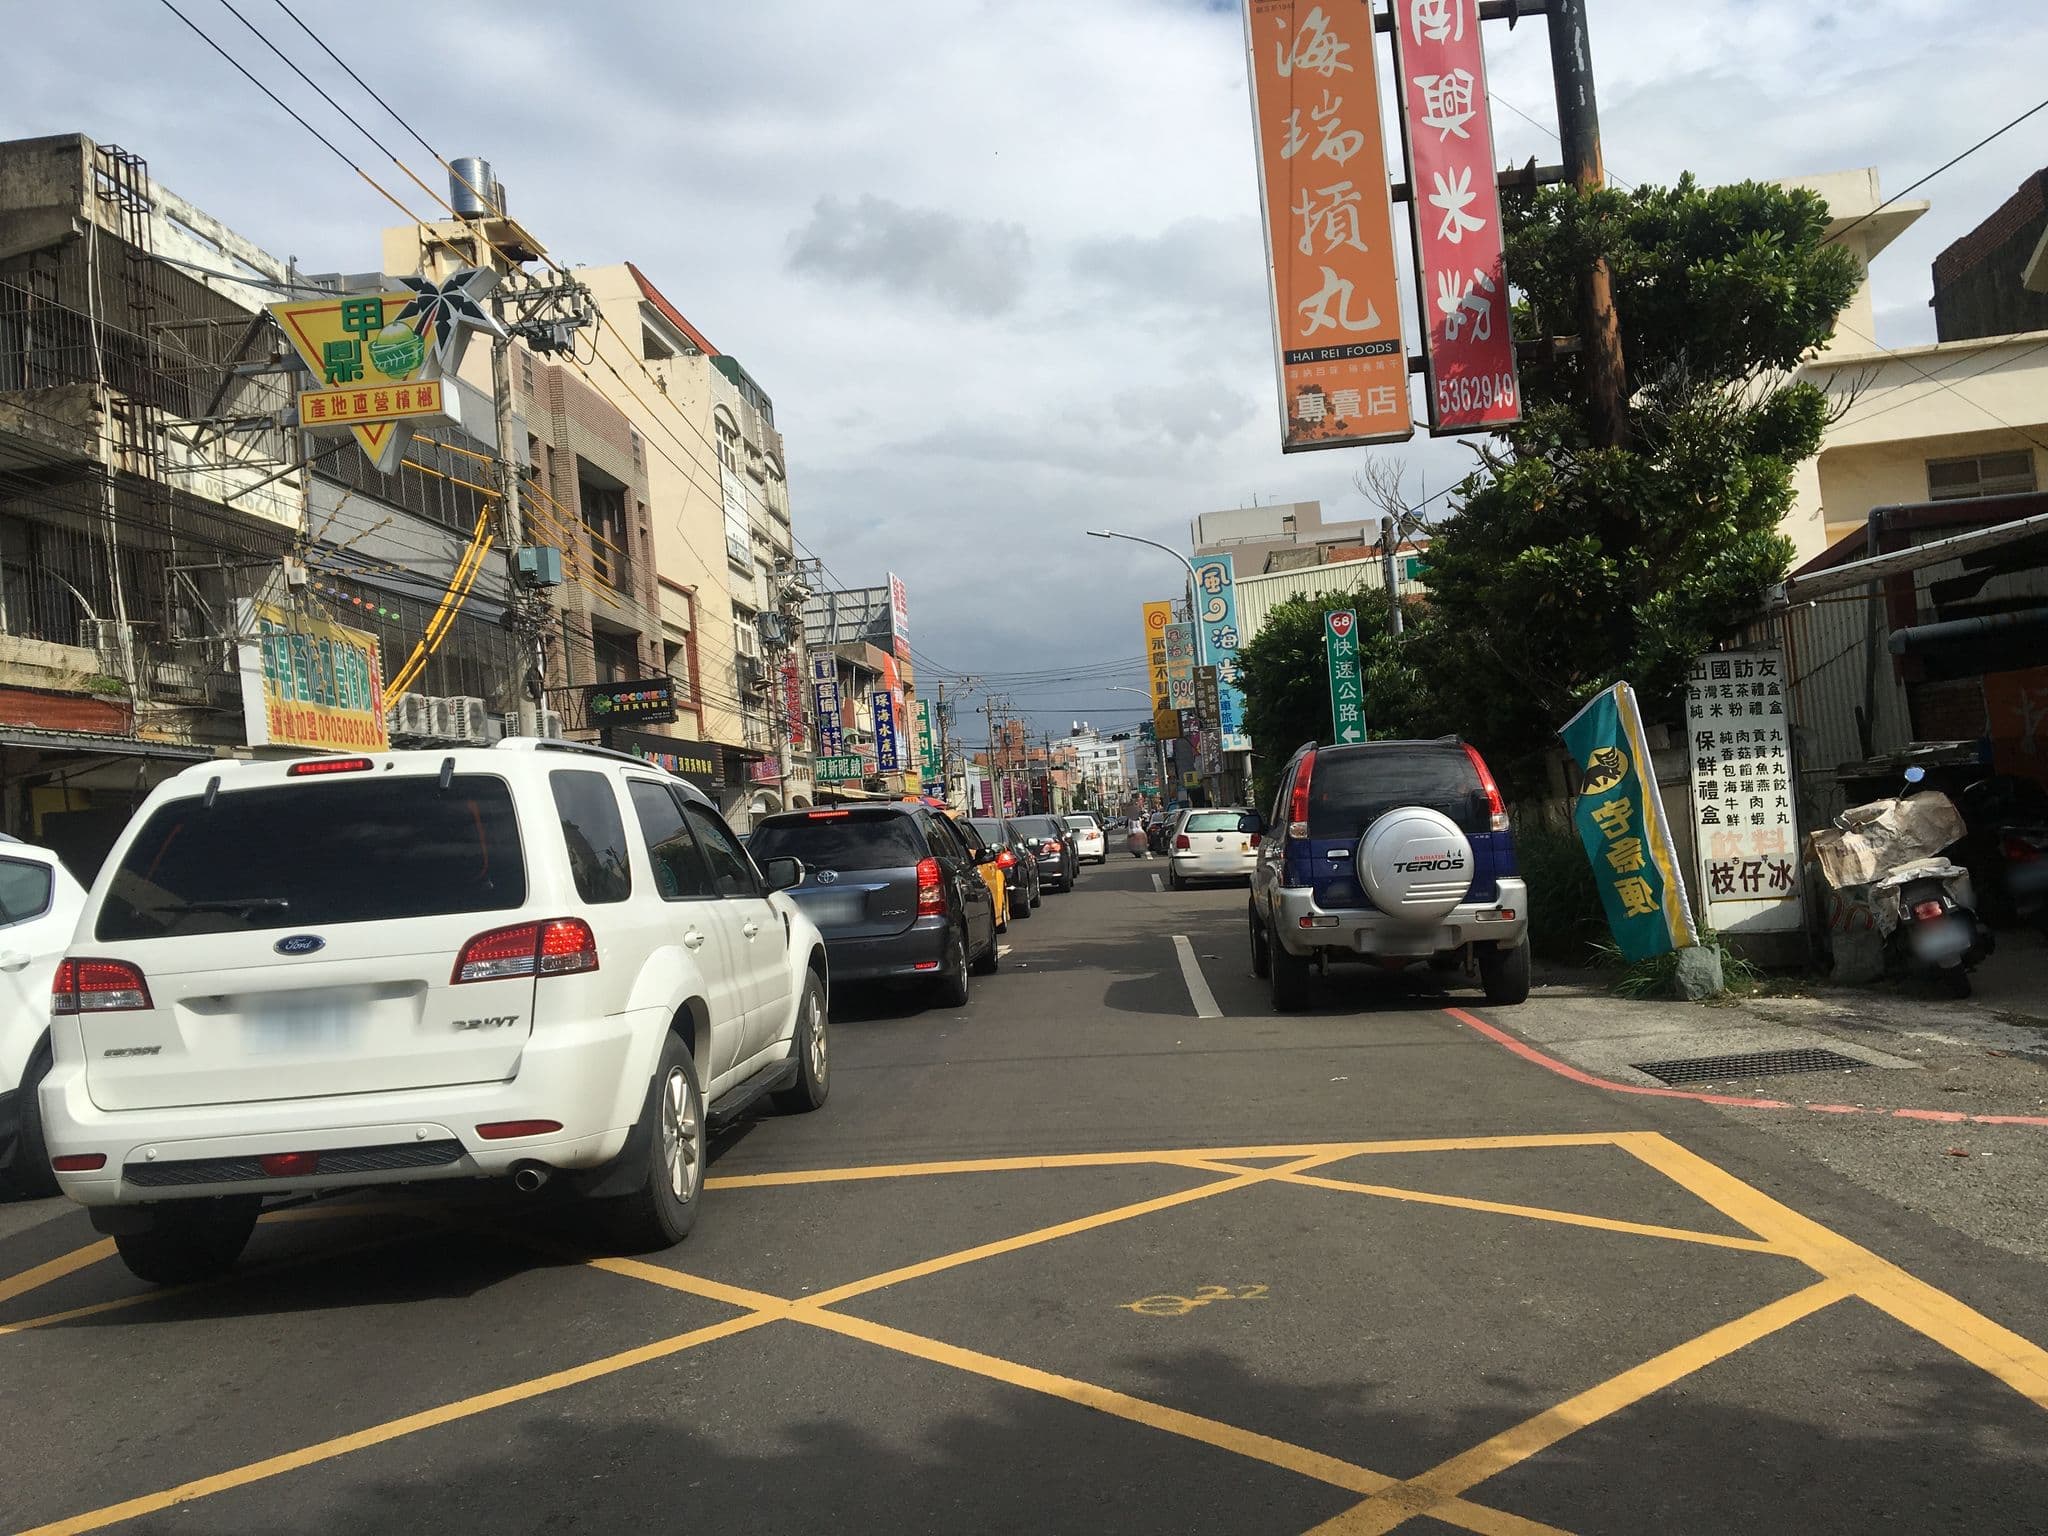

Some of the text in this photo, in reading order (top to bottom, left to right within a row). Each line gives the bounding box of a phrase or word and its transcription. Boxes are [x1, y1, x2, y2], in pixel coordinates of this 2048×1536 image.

[1293, 343, 1392, 362] HAI REI FOODS
[310, 386, 433, 418] 產地直營檳榔
[1439, 372, 1515, 413] 5362949
[1296, 385, 1397, 422] 專賣店
[1333, 616, 1350, 627] 68
[1689, 657, 1778, 681] 出國訪友
[1334, 638, 1359, 723] 快速公路
[1688, 681, 1782, 700] 台灣茗茶禮盒
[1689, 701, 1783, 719] 純米粉禮盒
[1719, 728, 1783, 745] 純肉貢丸
[1721, 745, 1785, 761] 香菇貢丸
[1695, 730, 1721, 825] 保鮮禮盒
[1724, 778, 1787, 795] 海瑞燕餃
[1725, 795, 1788, 811] 牛肉丸
[1726, 811, 1790, 827] 鮮蝦丸
[1393, 859, 1464, 873] TERIOS
[1710, 859, 1795, 894] 枝仔冰
